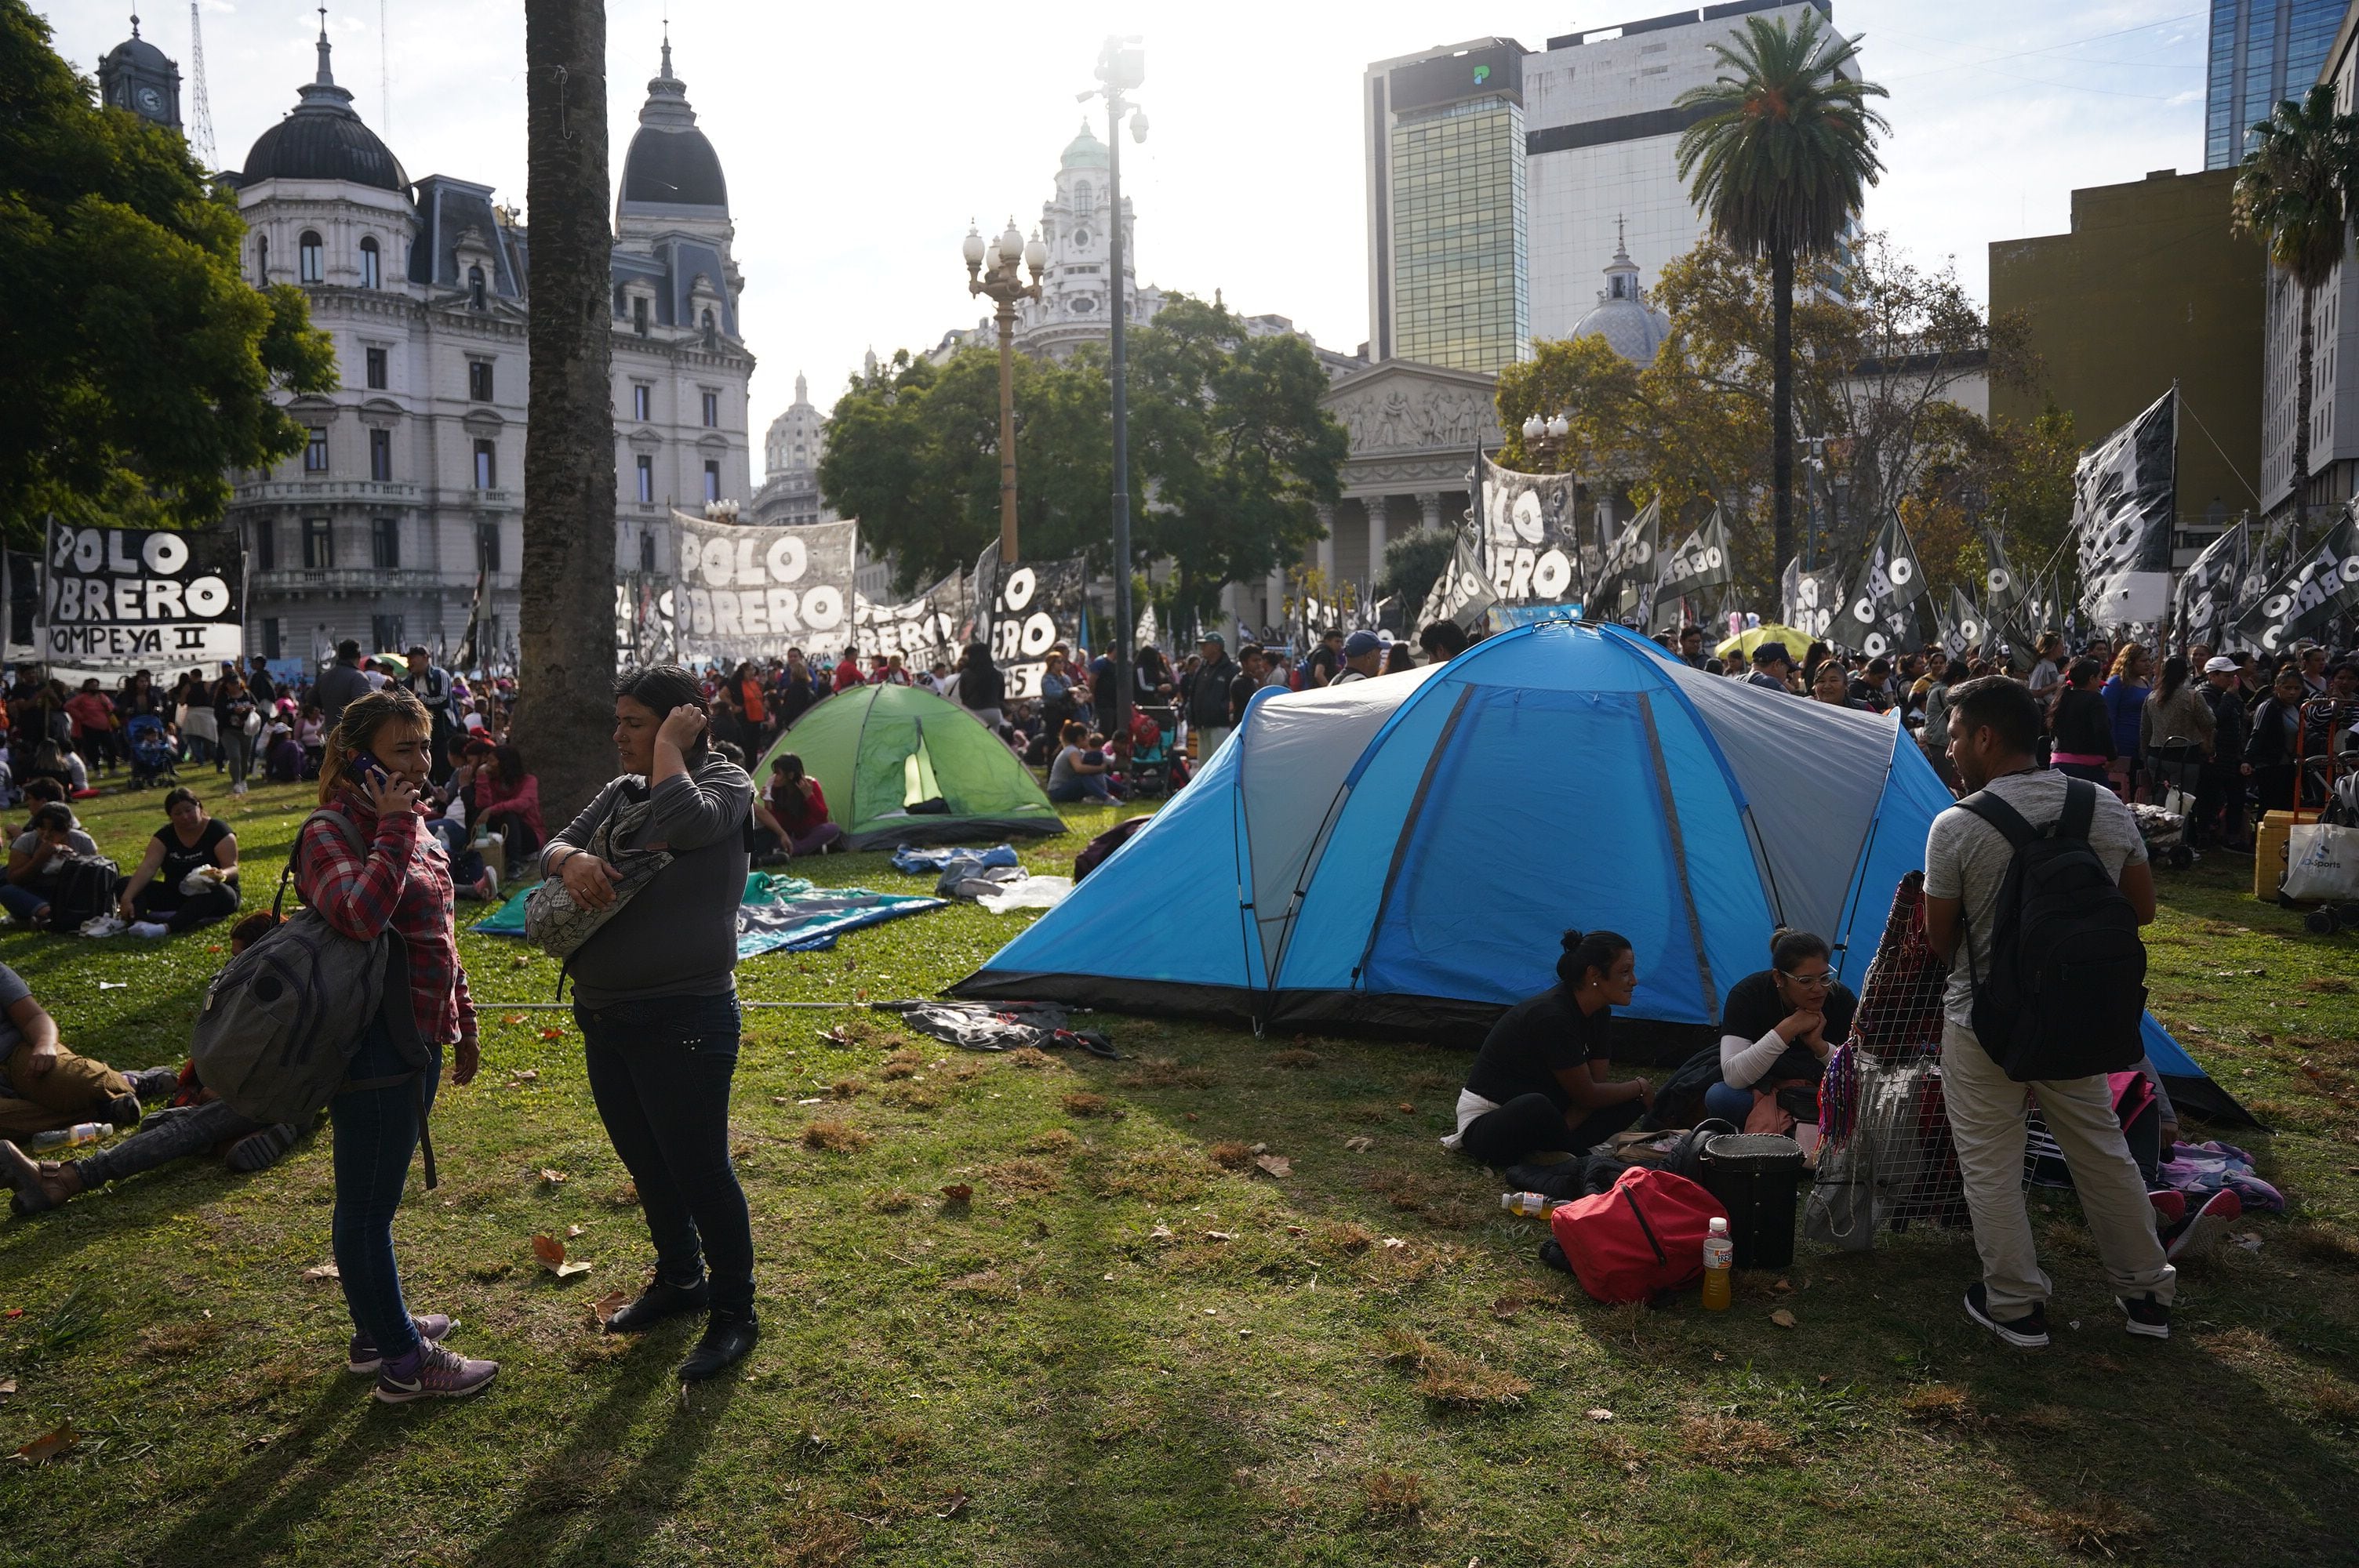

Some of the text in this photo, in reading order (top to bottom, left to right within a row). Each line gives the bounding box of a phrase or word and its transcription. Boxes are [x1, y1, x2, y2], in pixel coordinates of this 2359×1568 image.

[54, 525, 189, 575] POLO
[682, 532, 807, 586] POLO
[675, 585, 843, 634] OBRERO
[174, 627, 207, 649] II
